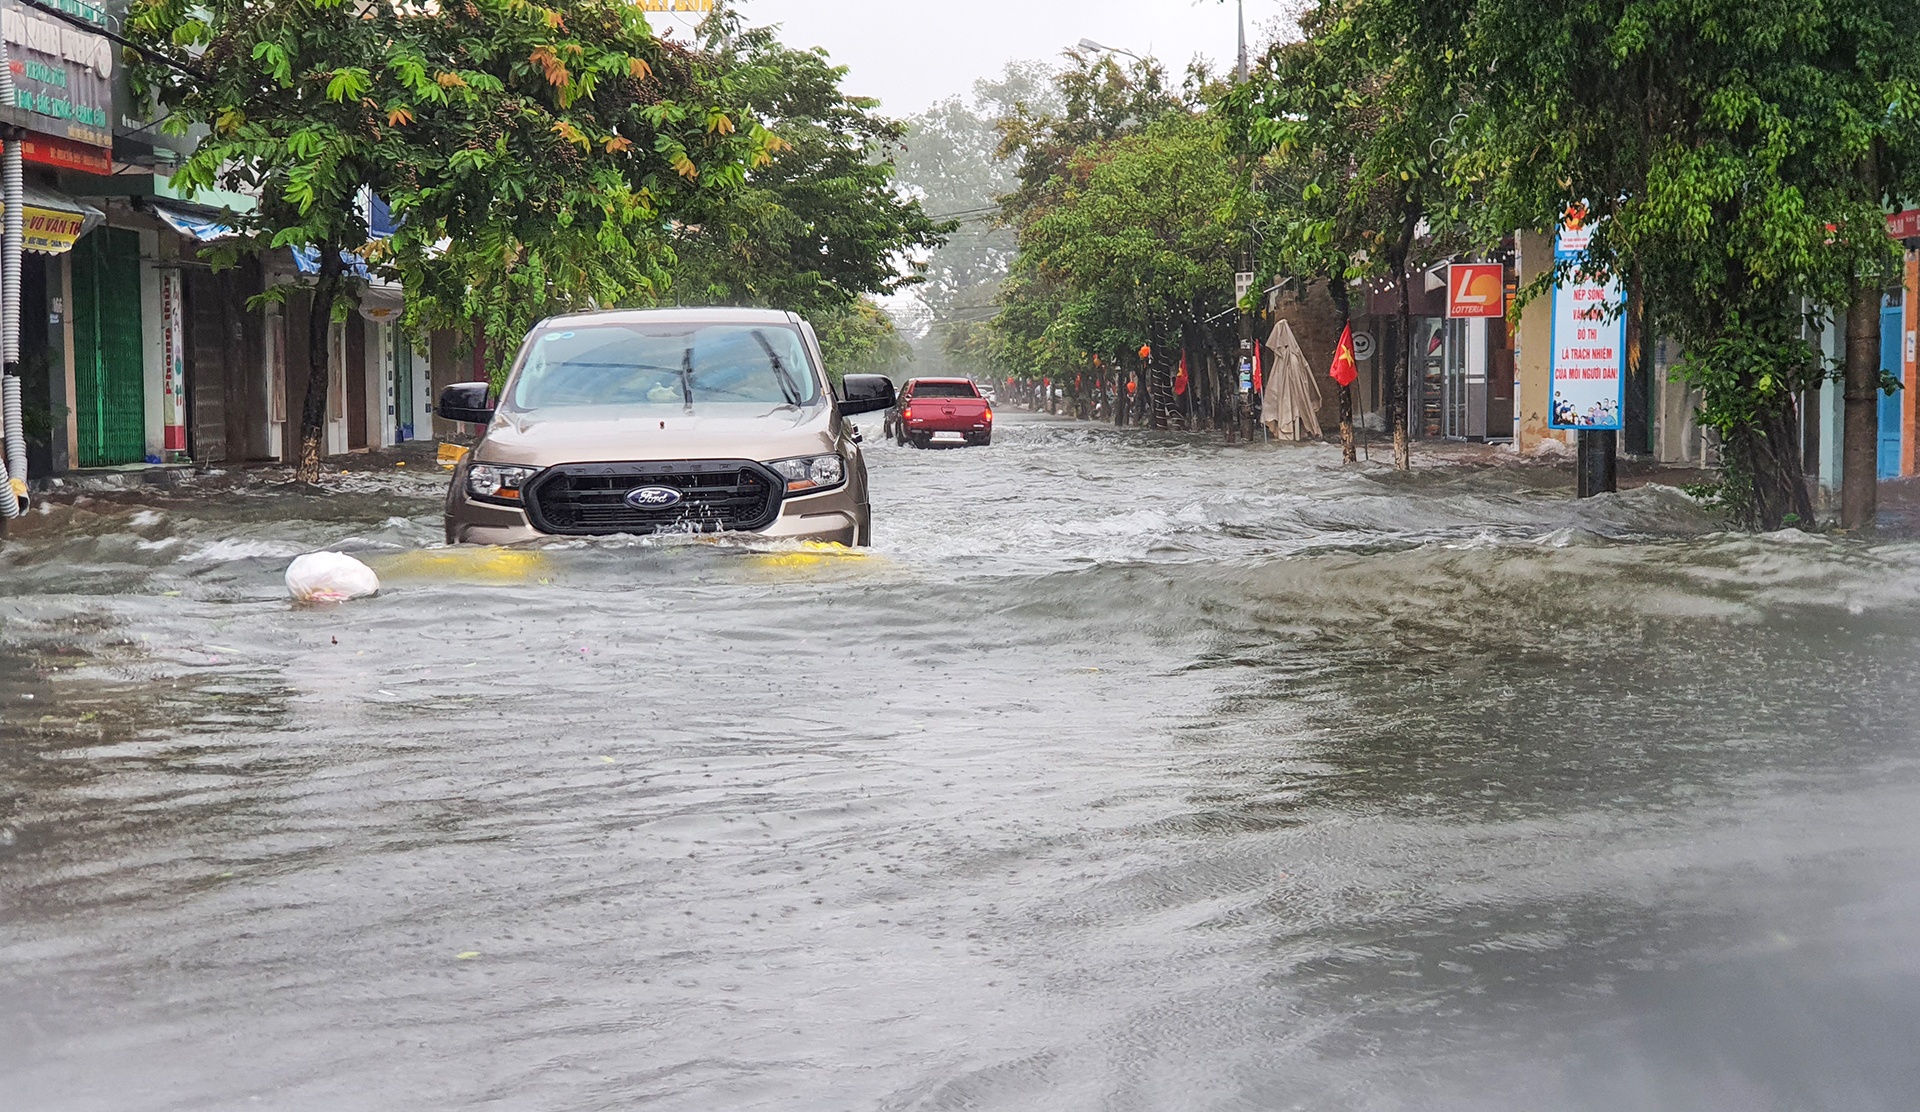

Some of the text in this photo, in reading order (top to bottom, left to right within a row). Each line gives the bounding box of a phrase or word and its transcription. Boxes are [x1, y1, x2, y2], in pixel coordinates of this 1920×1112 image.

[1452, 305, 1484, 313] LOTTERIA
[1587, 328, 1597, 342] THỊ
[1571, 346, 1590, 360] TRÁCH
[1592, 345, 1612, 362] NHIỆM
[1555, 364, 1567, 379] CỦA
[1582, 365, 1601, 379] NGƯỜI
[638, 490, 668, 503] Ford
